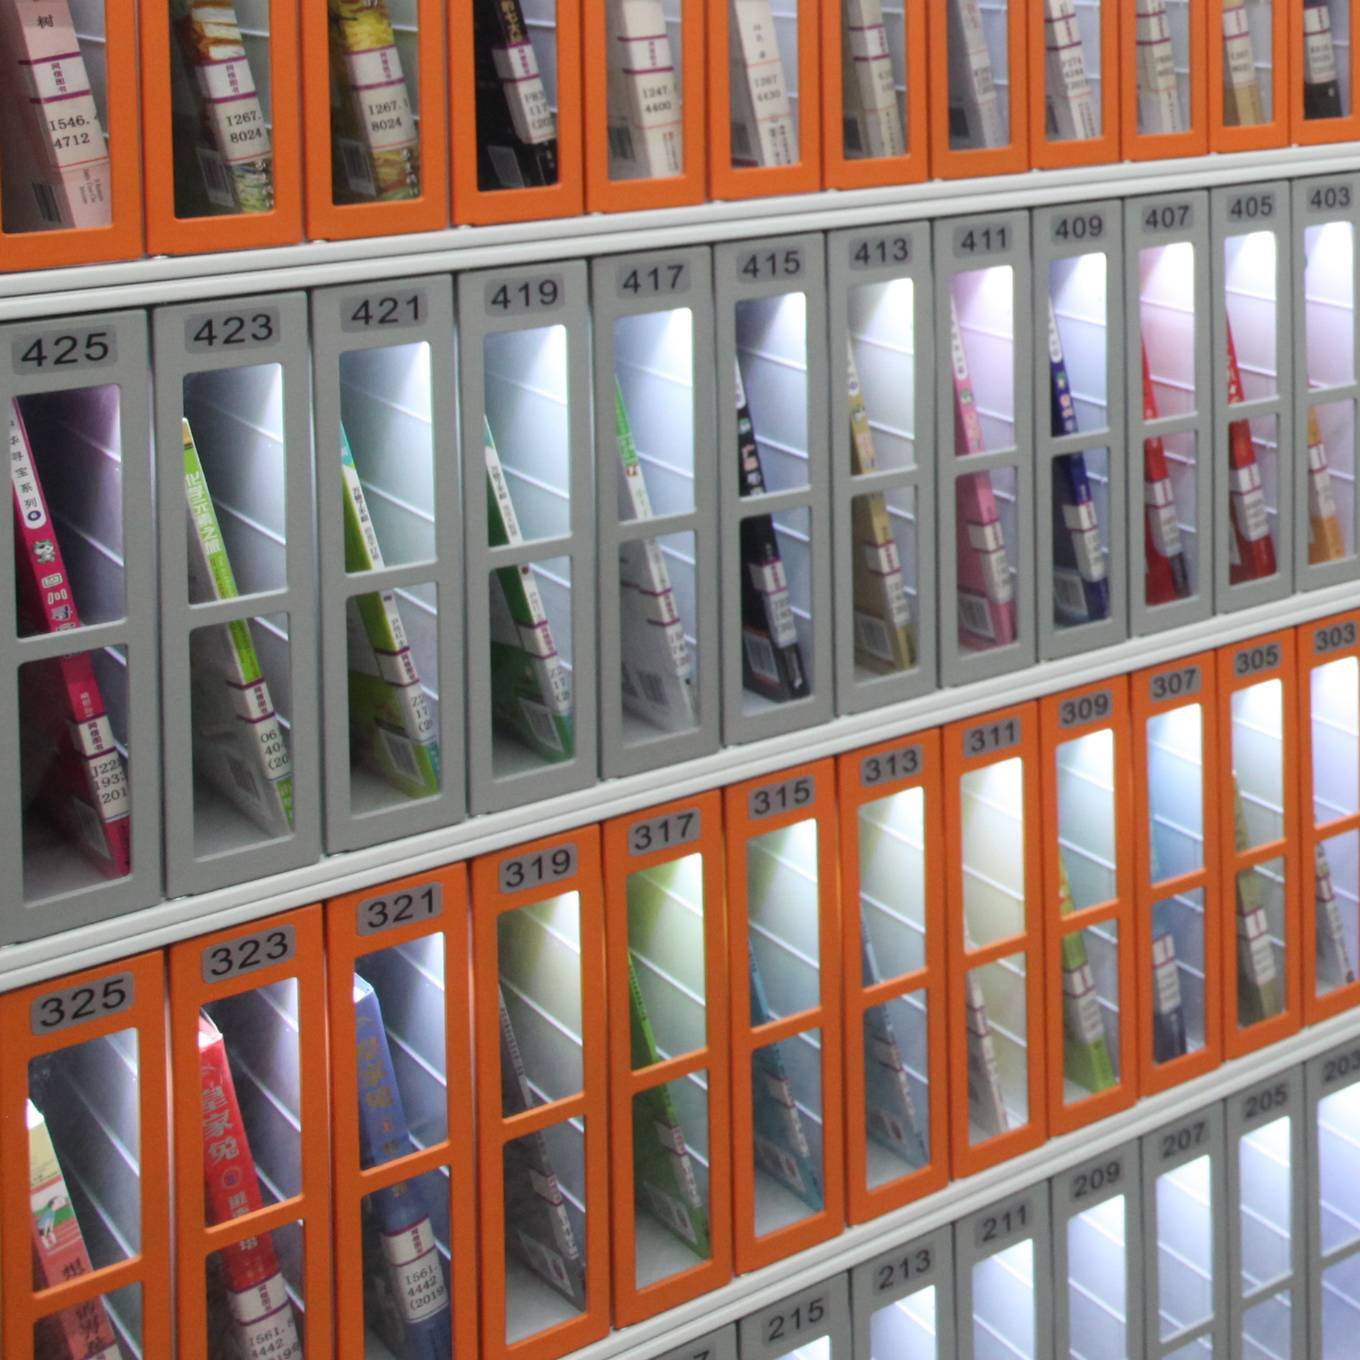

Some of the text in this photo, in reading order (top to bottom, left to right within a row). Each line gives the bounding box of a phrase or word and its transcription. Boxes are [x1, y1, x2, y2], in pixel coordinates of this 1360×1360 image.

[229, 128, 263, 144] 8024
[370, 118, 403, 132] 8024
[52, 133, 91, 151] 4712
[1230, 197, 1273, 220] 405
[1310, 187, 1351, 209] 403
[1055, 214, 1103, 240] 409
[1145, 205, 1190, 229] 407
[855, 238, 909, 266] 413
[961, 227, 1007, 252] 411
[622, 265, 685, 294] 417
[742, 250, 801, 279] 415
[351, 295, 419, 325] 421
[490, 279, 559, 310] 419
[193, 314, 274, 347] 423
[20, 332, 109, 368] 425
[1315, 625, 1356, 651] 303
[1236, 645, 1279, 674] 305
[1153, 670, 1197, 699] 307
[1061, 694, 1110, 725] 309
[970, 721, 1016, 753] 311
[864, 750, 918, 782] 313
[753, 779, 811, 815] 315
[633, 813, 695, 851] 317
[505, 849, 571, 888] 319
[366, 888, 436, 929] 321
[210, 932, 289, 976] 323
[40, 978, 126, 1027] 325
[1245, 1086, 1288, 1119] 205
[1163, 1122, 1206, 1158] 207
[1073, 1161, 1121, 1197] 209
[982, 1206, 1028, 1242] 211
[878, 1250, 931, 1290] 213
[406, 1275, 440, 1299] 4442
[767, 1299, 825, 1339] 215
